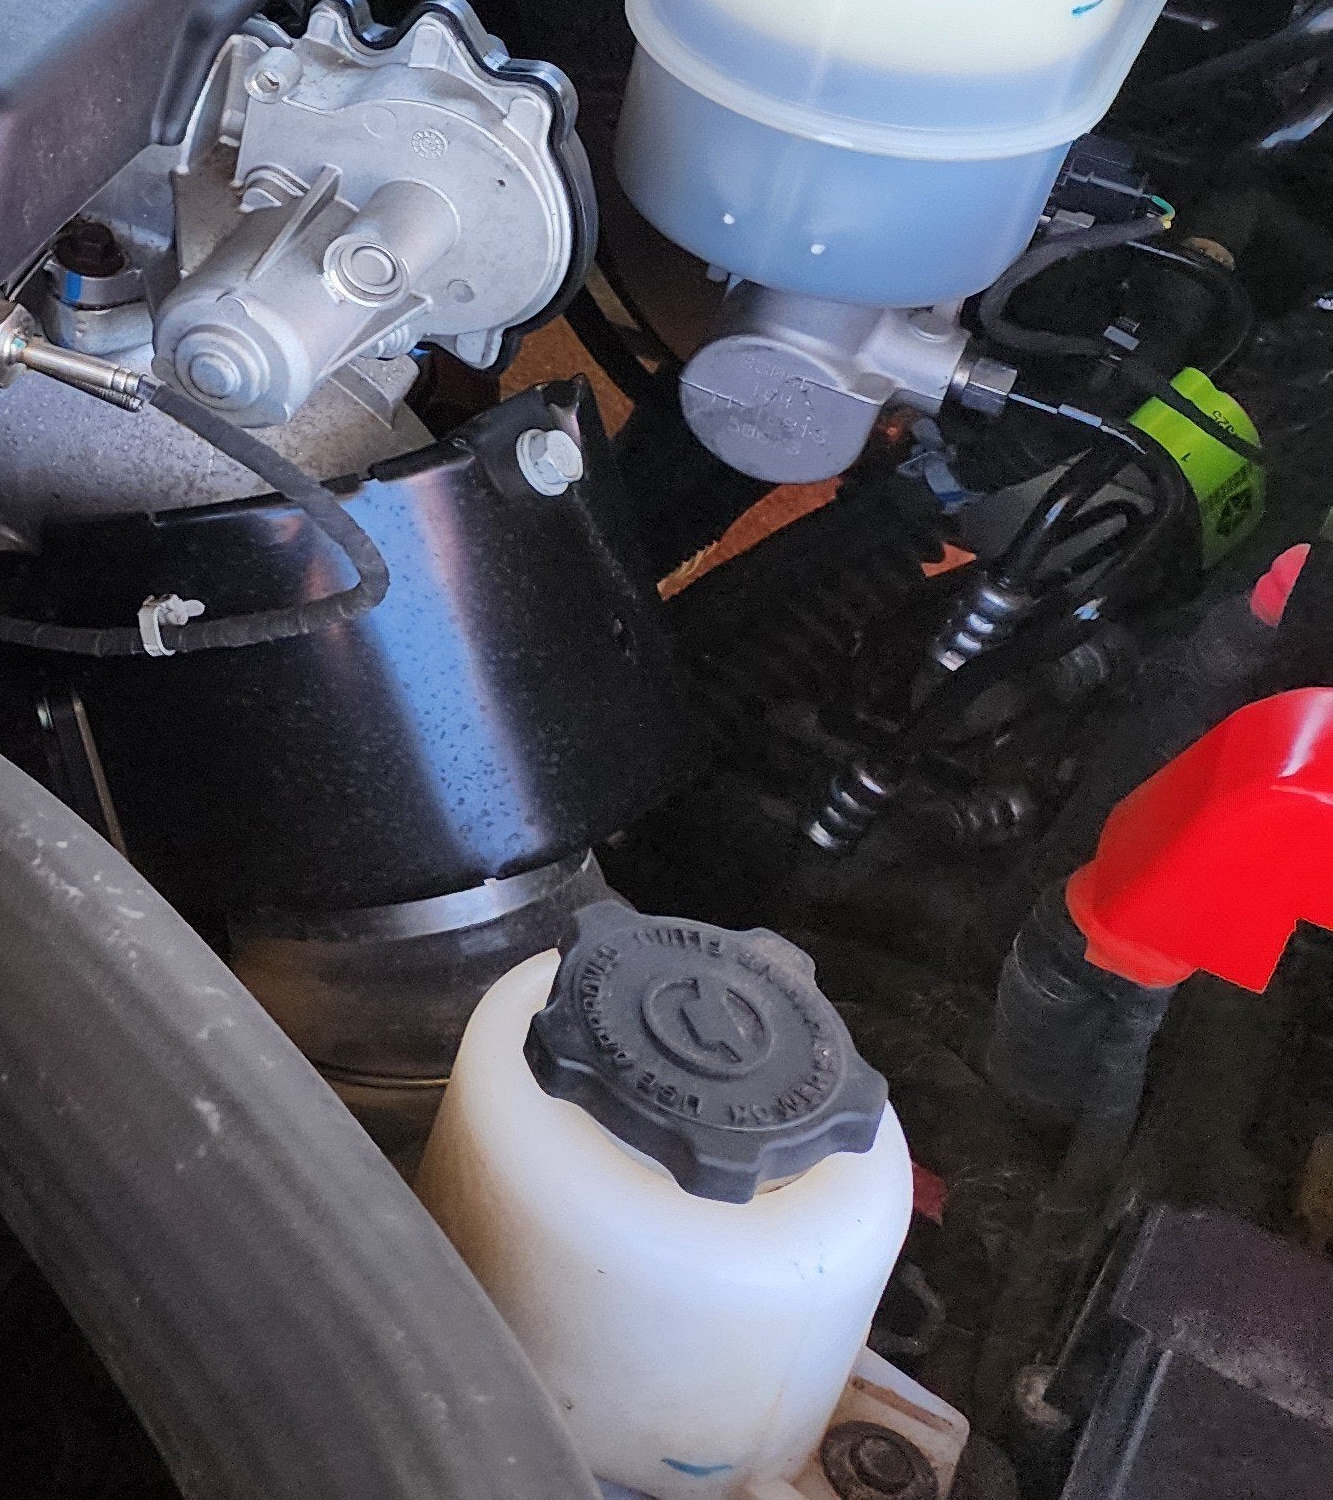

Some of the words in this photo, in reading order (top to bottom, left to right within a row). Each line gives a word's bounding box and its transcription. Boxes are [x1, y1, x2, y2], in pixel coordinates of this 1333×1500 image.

[580, 943, 640, 1069] APPROVED
[635, 1070, 702, 1118] USE
[725, 1074, 830, 1126] POWER
